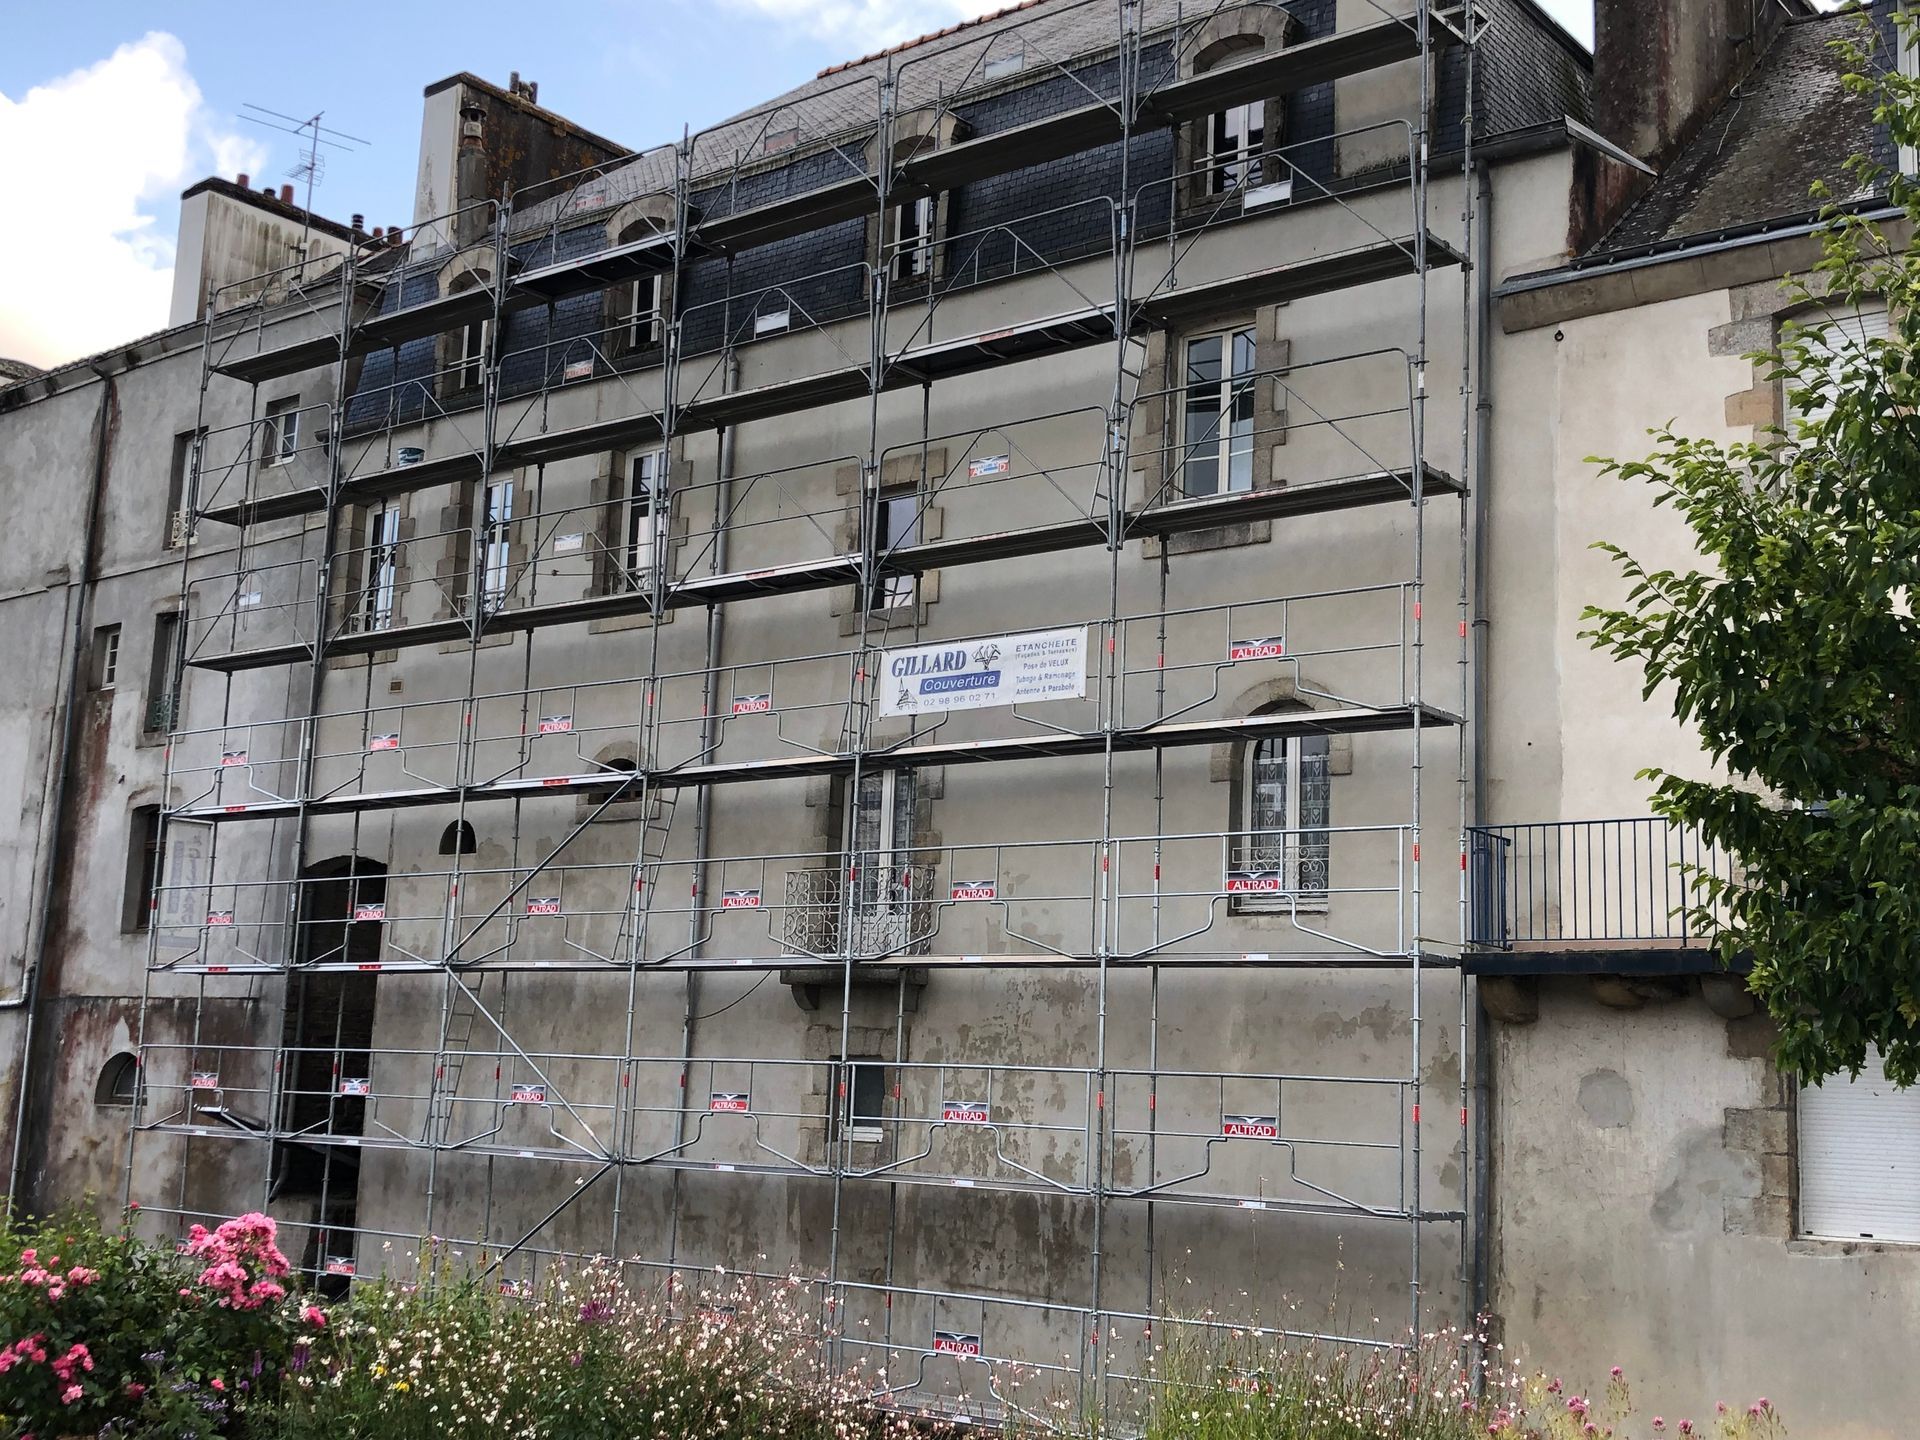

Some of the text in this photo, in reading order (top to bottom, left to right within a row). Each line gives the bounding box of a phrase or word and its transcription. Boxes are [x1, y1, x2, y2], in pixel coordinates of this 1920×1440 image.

[1016, 639, 1077, 652] ETANCHEITE
[1236, 646, 1277, 658] ALTRAD
[892, 650, 967, 677] GILLARD
[1048, 659, 1069, 667] VELUX
[924, 675, 996, 691] Couverture
[1048, 683, 1075, 692] Parabole
[923, 698, 935, 706] 02
[939, 697, 950, 705] 98
[969, 694, 981, 702] 02
[985, 692, 995, 700] 71
[738, 702, 766, 712] ALTRAD
[543, 723, 568, 731] ALTRAD
[1233, 880, 1274, 890] ALTRAD
[957, 888, 990, 898] ALTRAD
[727, 897, 755, 906] ALTRAD
[713, 1101, 737, 1109] ALTRAD
[948, 1111, 983, 1120] ALTRAD
[1230, 1125, 1271, 1135] ALTRAD
[940, 1341, 975, 1353] ALTRAD
